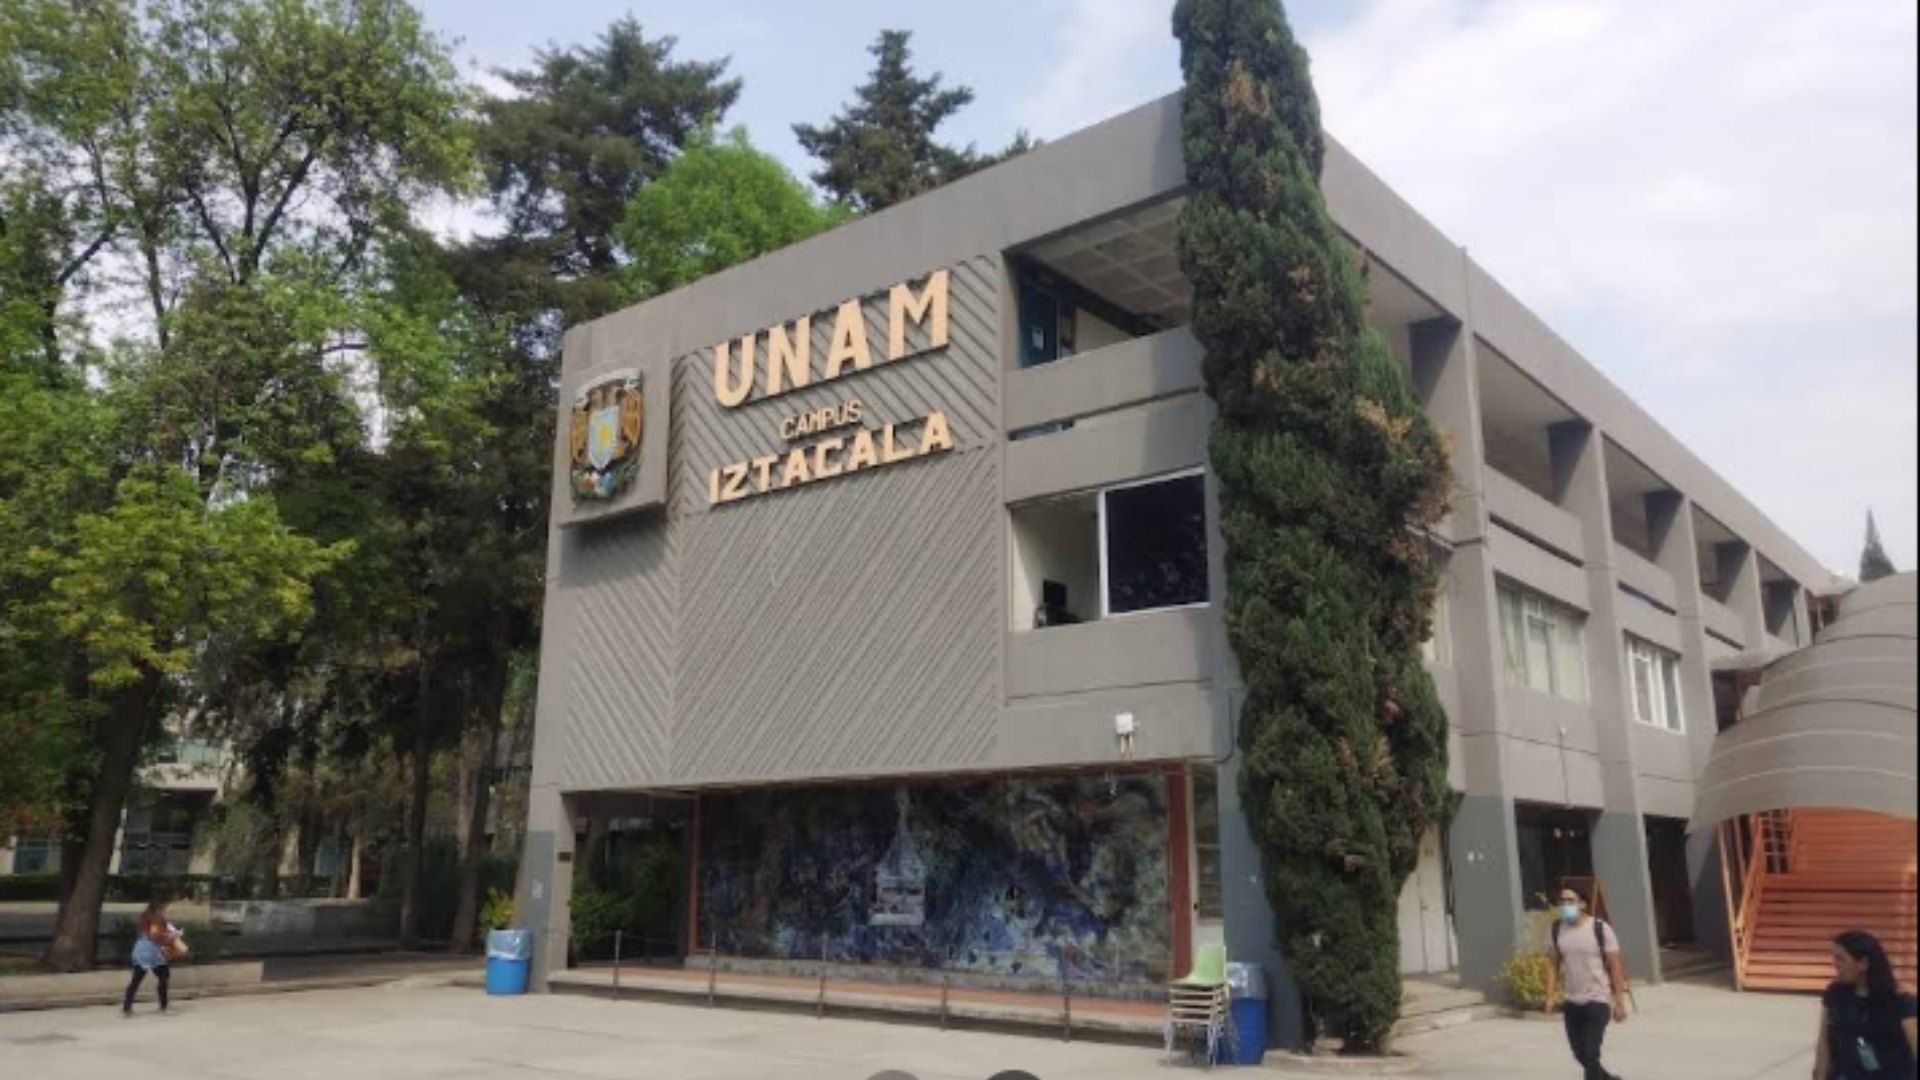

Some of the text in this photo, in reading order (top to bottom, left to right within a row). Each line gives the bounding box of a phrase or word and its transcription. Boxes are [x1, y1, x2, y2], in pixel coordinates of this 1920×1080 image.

[715, 270, 949, 407] UNAM
[710, 412, 953, 503] IZTACALA
[782, 401, 863, 439] CAMPUS
